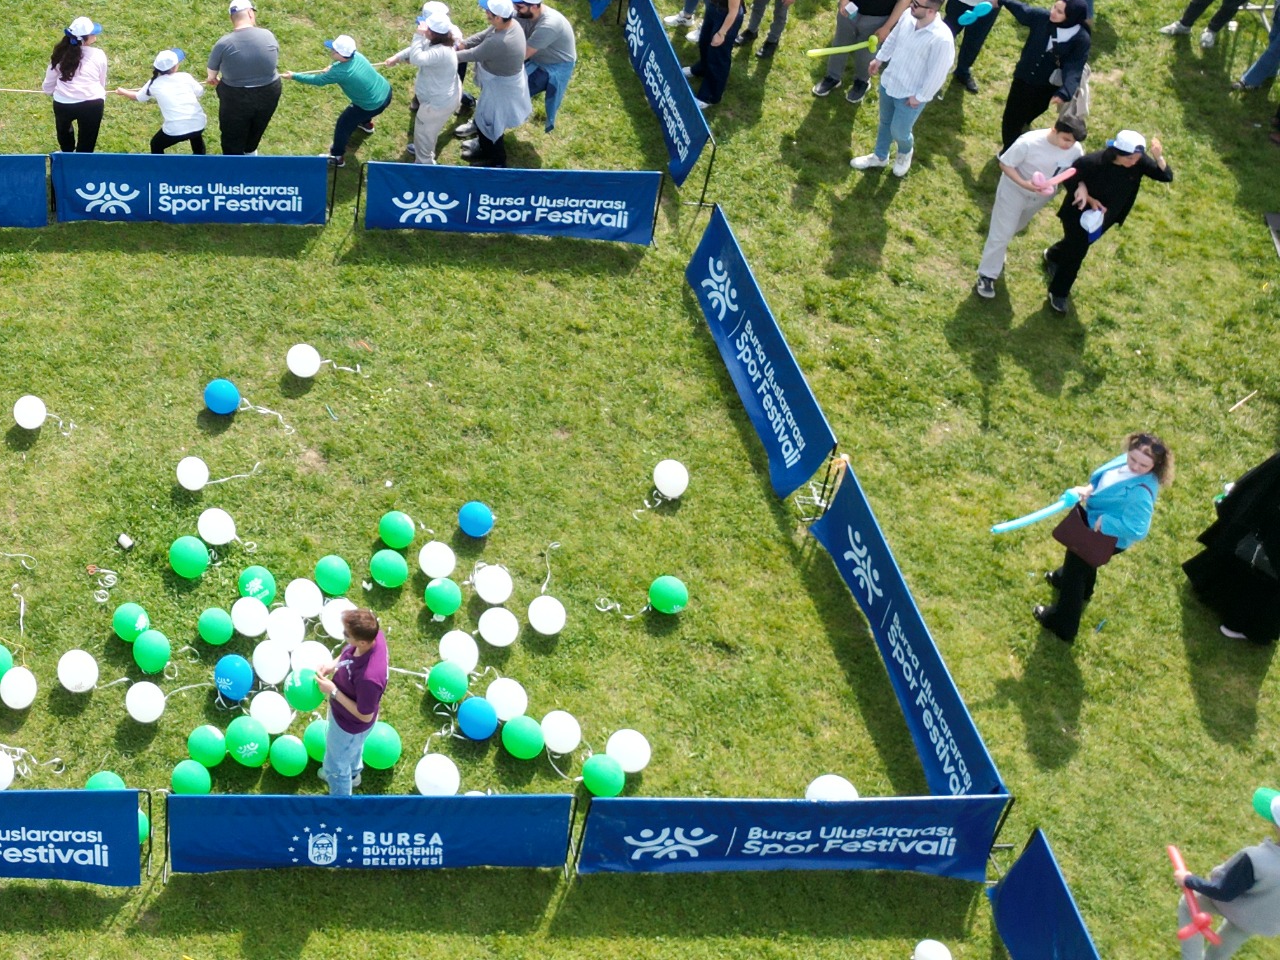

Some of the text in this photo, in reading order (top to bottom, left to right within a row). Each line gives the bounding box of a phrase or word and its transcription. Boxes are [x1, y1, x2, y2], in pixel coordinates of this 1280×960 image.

[643, 61, 662, 101] Spor
[158, 183, 299, 196] Bursa Uluslararası
[158, 195, 303, 215] Spor Festivali
[479, 194, 626, 210] Bursa Uluslararası
[476, 206, 629, 229] Spor Festivali
[744, 319, 766, 364] Bursa
[736, 335, 802, 469] Spor Festivali
[887, 624, 918, 691] Spor
[362, 831, 443, 846] BURSA
[747, 826, 954, 841] Bursa Uluslararası
[363, 845, 443, 857] BÜYÜKŞEHİR
[741, 837, 958, 856] Spor Festivali
[363, 854, 443, 866] BELEDİYESİ
